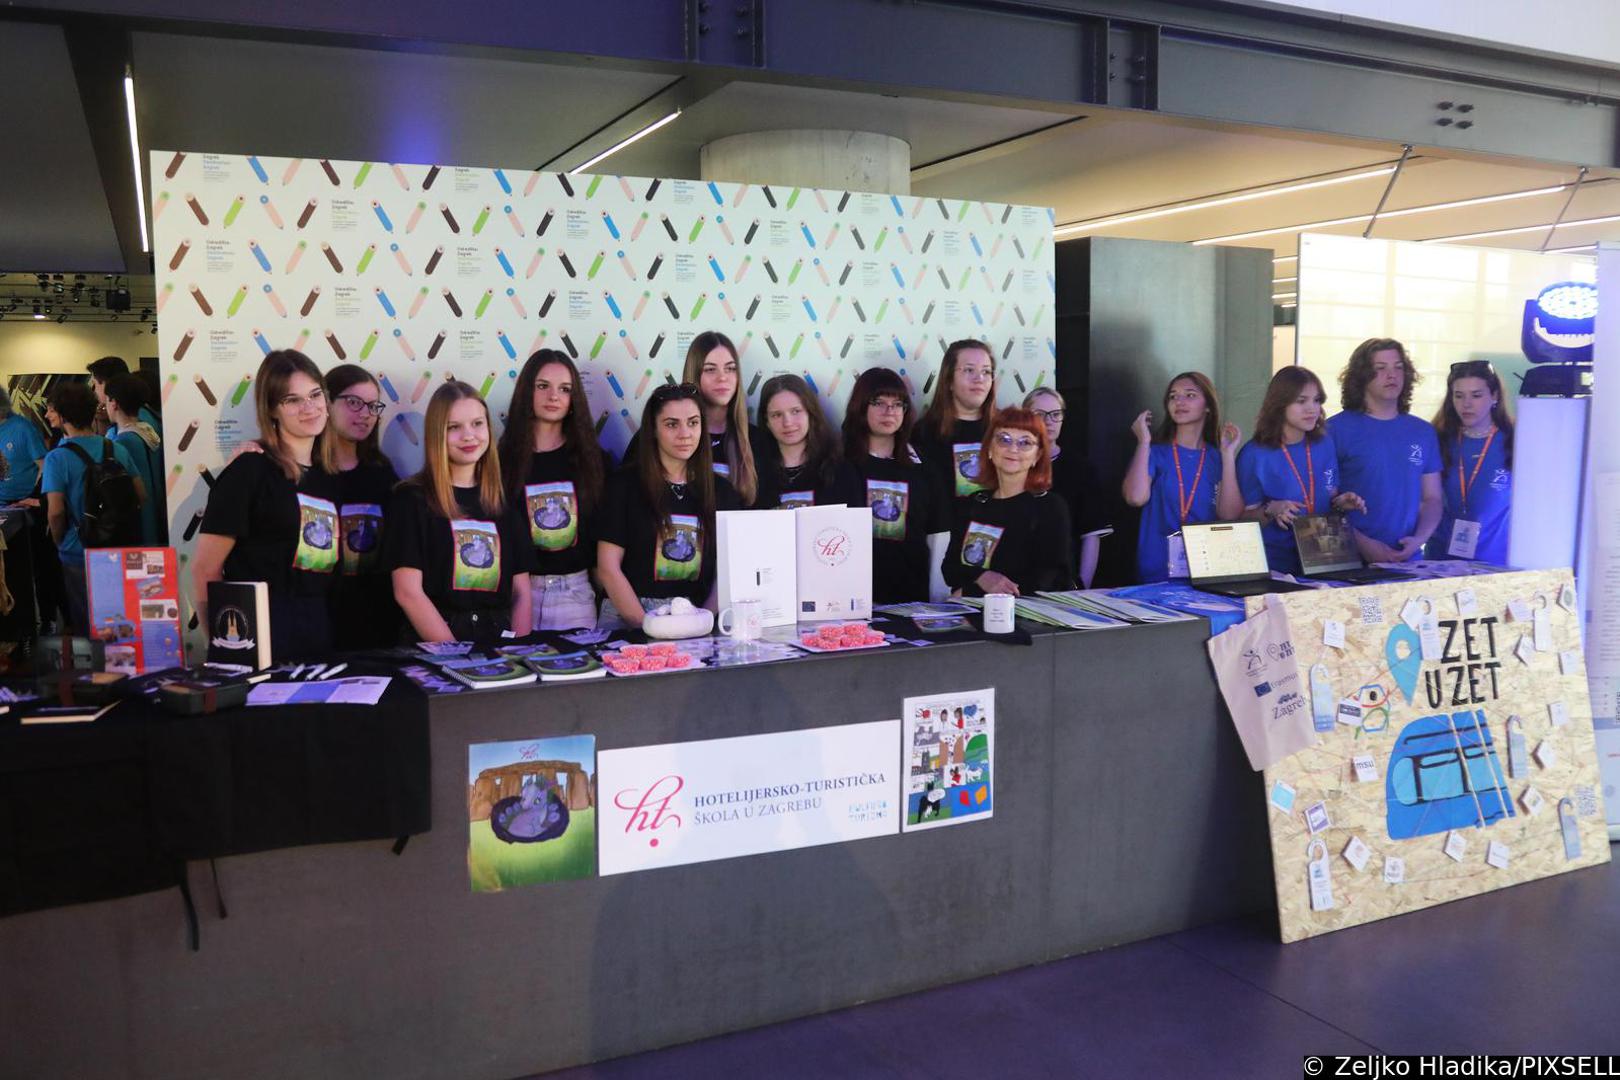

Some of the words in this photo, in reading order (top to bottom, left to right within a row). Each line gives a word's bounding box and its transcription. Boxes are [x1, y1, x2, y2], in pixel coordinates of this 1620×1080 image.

[1438, 617, 1498, 664] ZET
[694, 773, 886, 807] HOTELIJERSKO-TURISTIČKA
[694, 808, 740, 825] ŠKOLA
[744, 805, 755, 818] U
[758, 797, 823, 817] ZAGREBU
